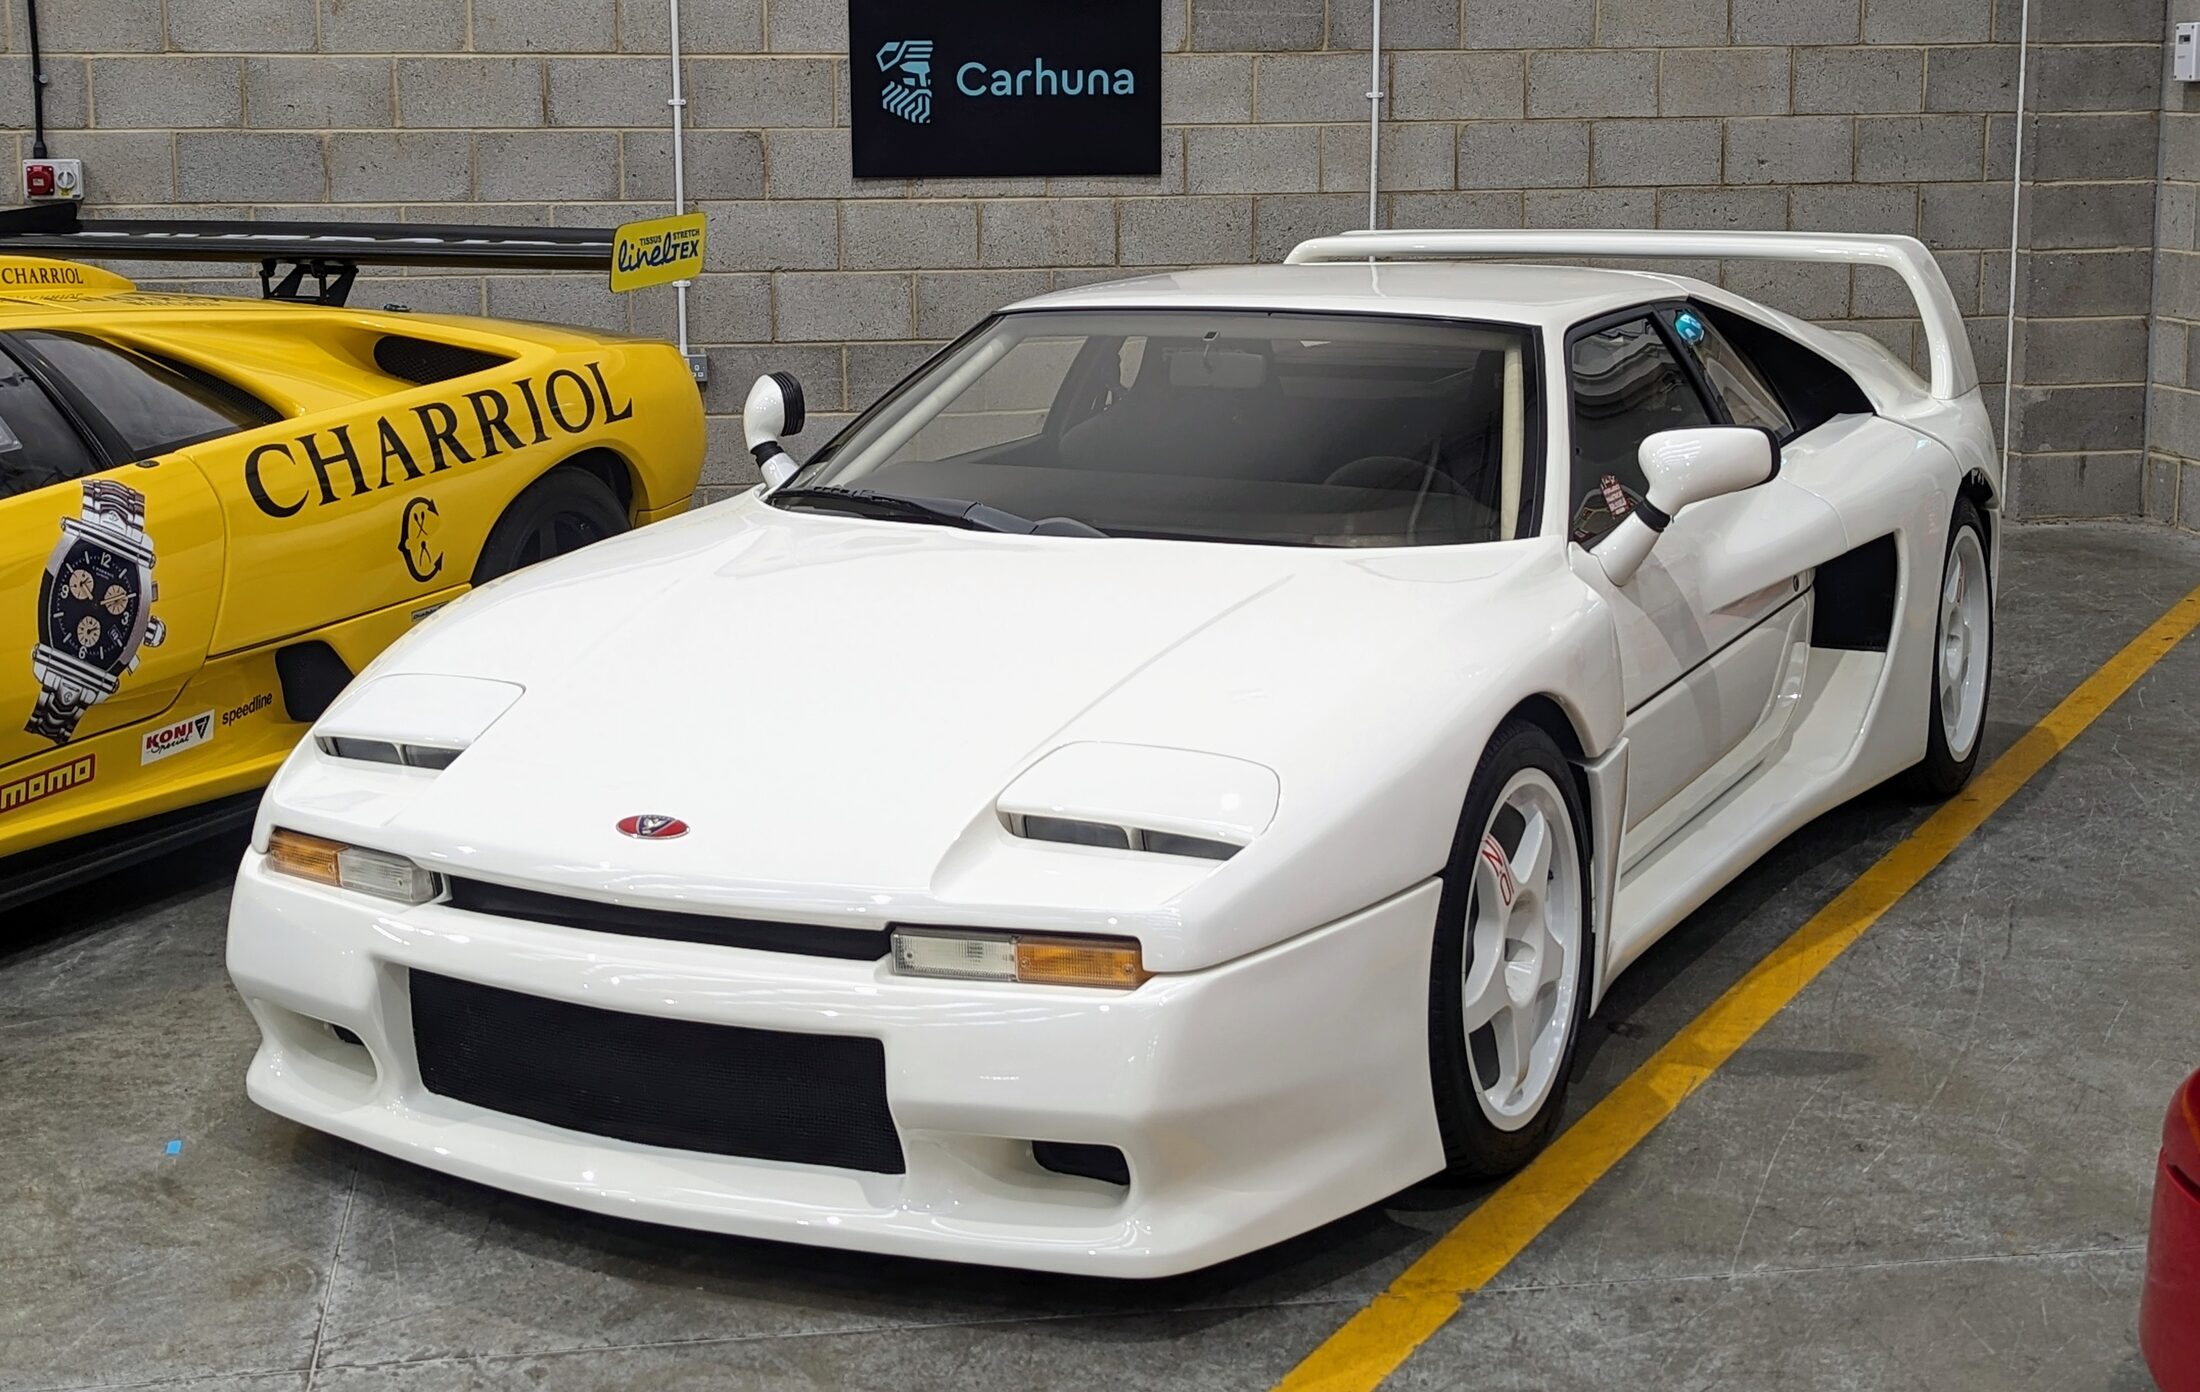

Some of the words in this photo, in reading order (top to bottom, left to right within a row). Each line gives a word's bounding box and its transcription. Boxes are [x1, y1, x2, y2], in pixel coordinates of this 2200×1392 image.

[956, 57, 1135, 96] Carhuna
[640, 235, 662, 246] TISSUS
[673, 229, 700, 240] STRETCH
[1, 267, 84, 284] CHARRIOL
[244, 361, 633, 519] CHARRIOL
[222, 692, 272, 726] speedline
[146, 721, 193, 750] KONI
[150, 732, 190, 754] Special
